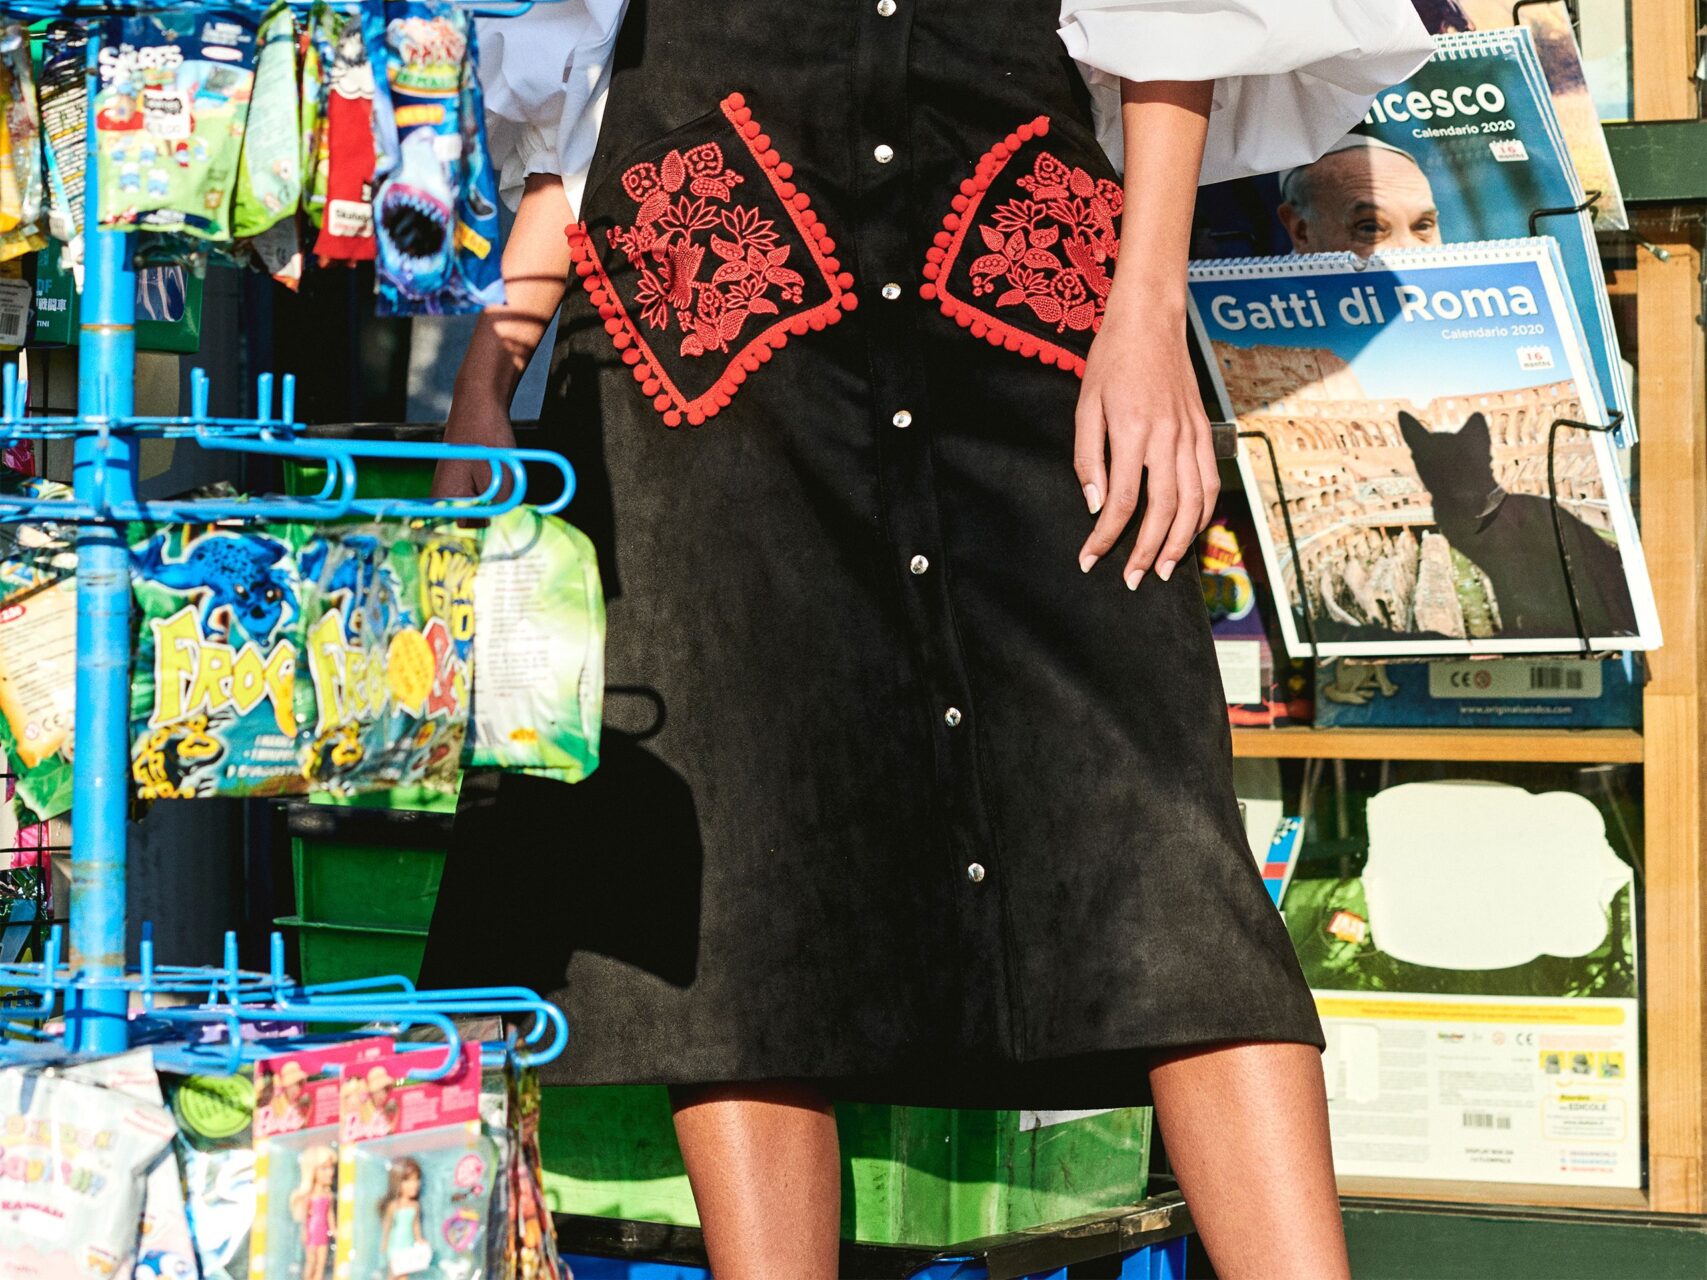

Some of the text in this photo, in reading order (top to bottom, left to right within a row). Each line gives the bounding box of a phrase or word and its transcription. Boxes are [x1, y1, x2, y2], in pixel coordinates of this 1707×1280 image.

[1363, 82, 1506, 124] ncesco
[1412, 119, 1516, 139] Calendario 2020
[1210, 283, 1539, 332] Gatti di Roma
[1441, 323, 1545, 340] Calendario 2020
[1526, 351, 1544, 362] 16
